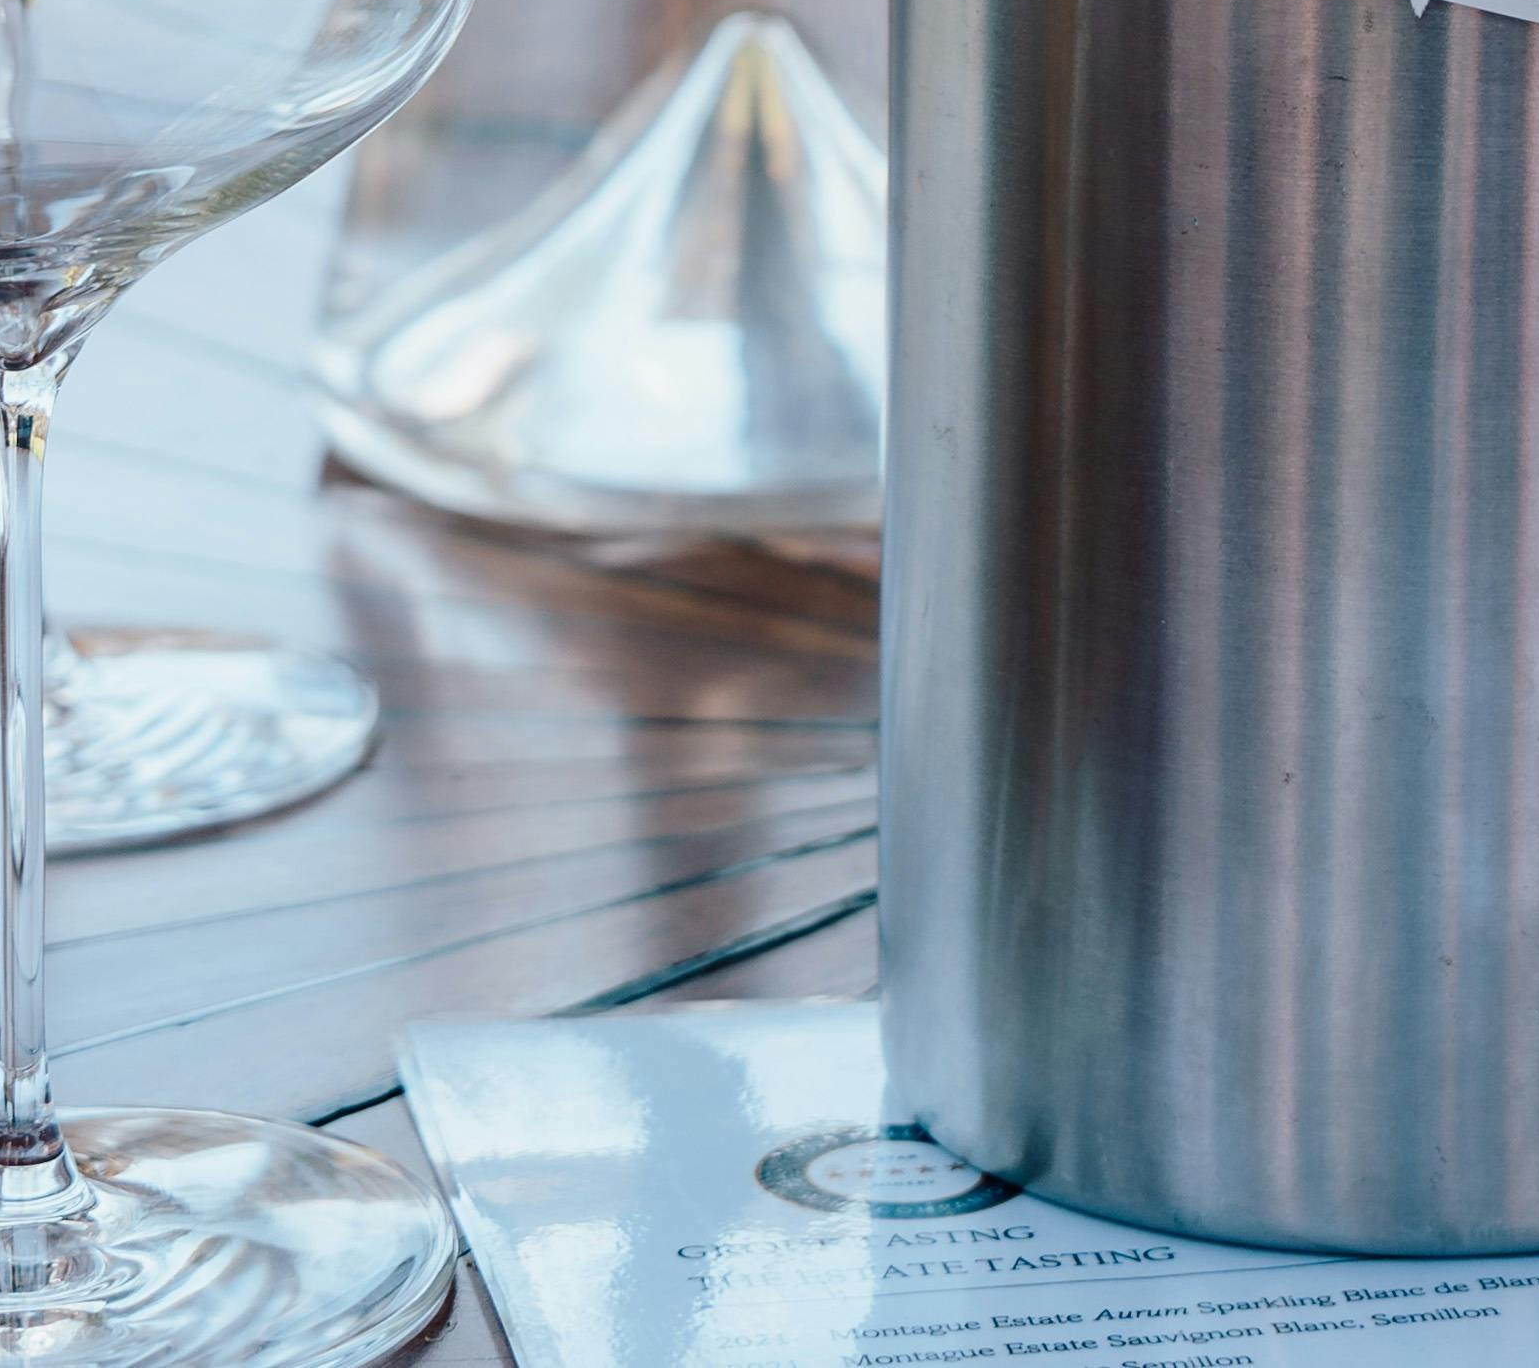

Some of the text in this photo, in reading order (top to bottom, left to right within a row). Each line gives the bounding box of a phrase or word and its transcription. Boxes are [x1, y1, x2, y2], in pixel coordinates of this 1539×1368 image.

[861, 1225, 1036, 1250] ASTNG
[974, 1246, 1177, 1274] TASTING
[829, 1317, 981, 1341] Montague
[990, 1310, 1083, 1329] Estate
[1092, 1305, 1190, 1322] Aurum
[1196, 1293, 1337, 1316] Sparkling
[1342, 1284, 1425, 1302] Blanc
[1433, 1280, 1470, 1295] de
[840, 1342, 997, 1368] Montague
[1003, 1338, 1099, 1355] Estate
[1107, 1326, 1263, 1347] Sauvignon
[1270, 1317, 1366, 1335] Blanc,
[1372, 1306, 1502, 1327] Semillon
[1122, 1354, 1254, 1368] Semillon
